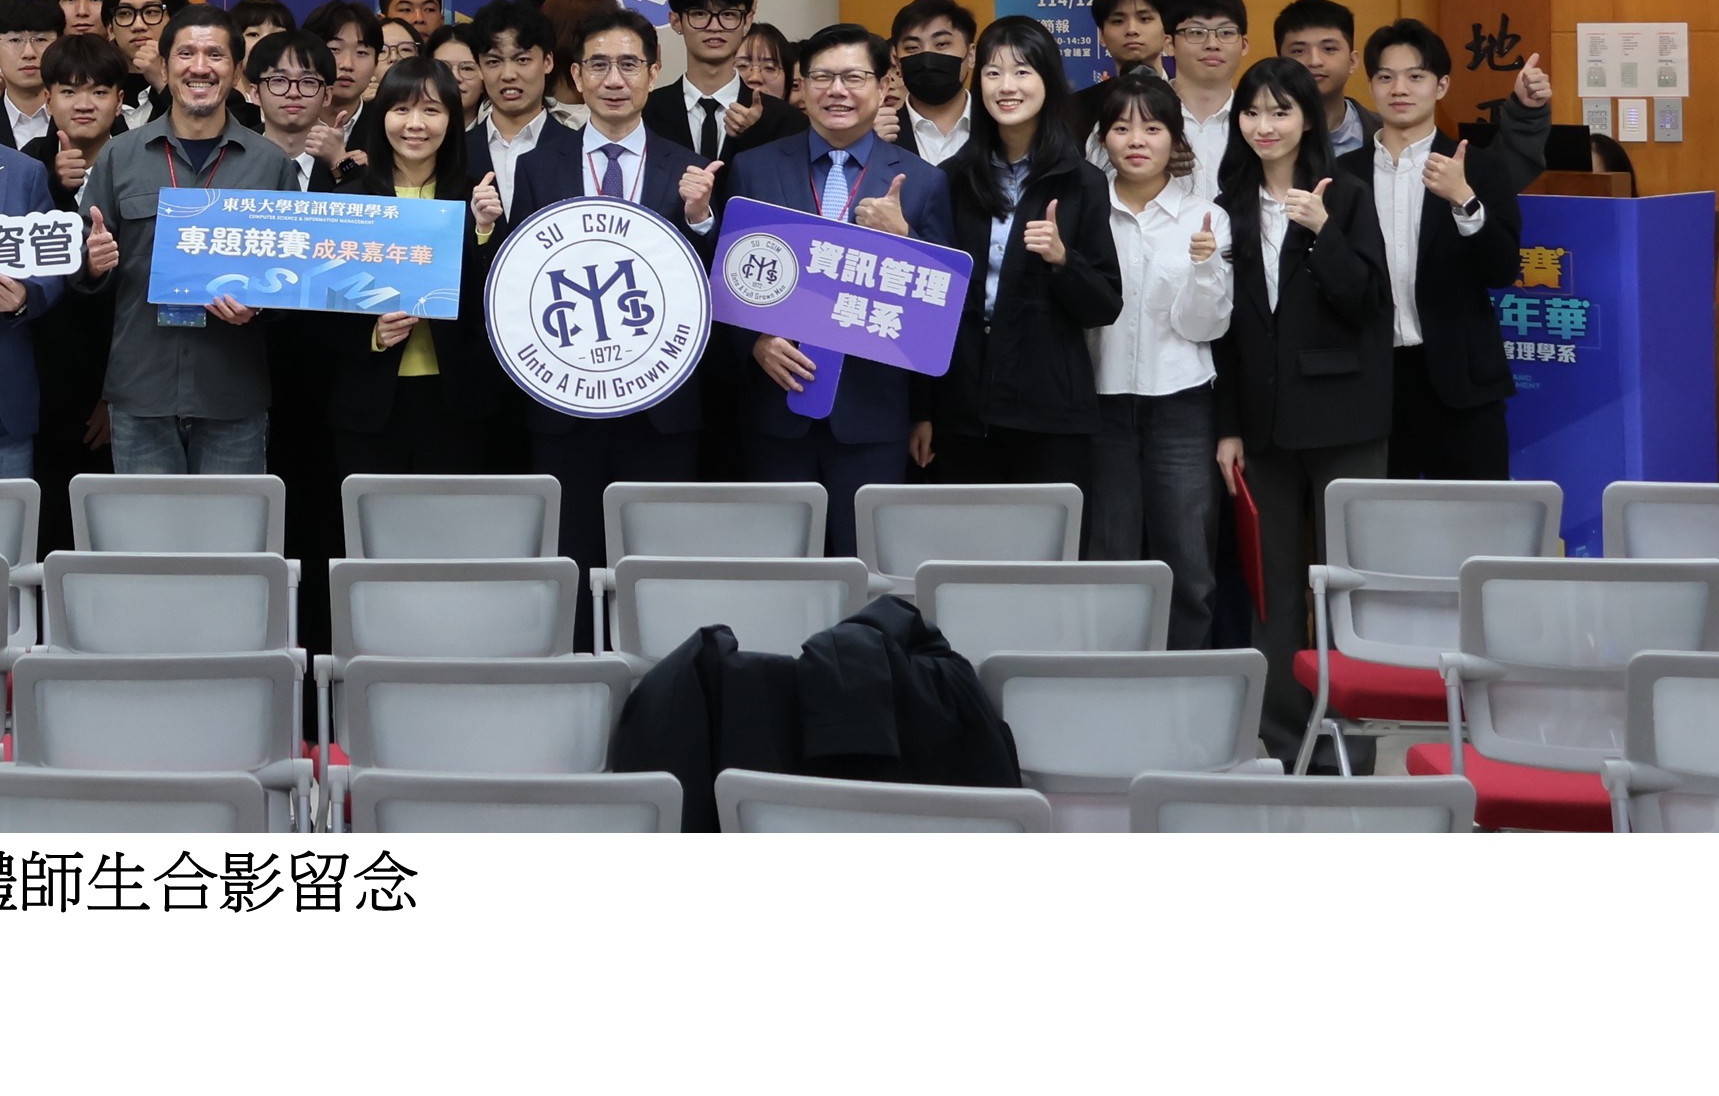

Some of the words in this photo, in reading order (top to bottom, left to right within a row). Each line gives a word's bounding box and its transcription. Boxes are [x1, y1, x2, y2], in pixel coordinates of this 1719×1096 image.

[1037, 19, 1070, 34] 簡報
[1055, 36, 1091, 45] 0-14:30
[1059, 48, 1091, 57] 會議室
[223, 197, 399, 219] 東吳大學資訊管理學系
[176, 227, 310, 260] 專題競賽
[536, 223, 564, 250] SU
[582, 214, 631, 238] CSIM
[312, 239, 433, 266] 成果嘉年華
[806, 240, 951, 306] 資訊管理
[831, 292, 904, 340] 學系
[1490, 294, 1587, 340] 年華
[517, 343, 554, 384] Unto
[556, 373, 569, 393] A
[575, 378, 607, 400] Full
[612, 360, 669, 398] Grown
[660, 323, 691, 360] Man
[590, 345, 622, 364] 1972
